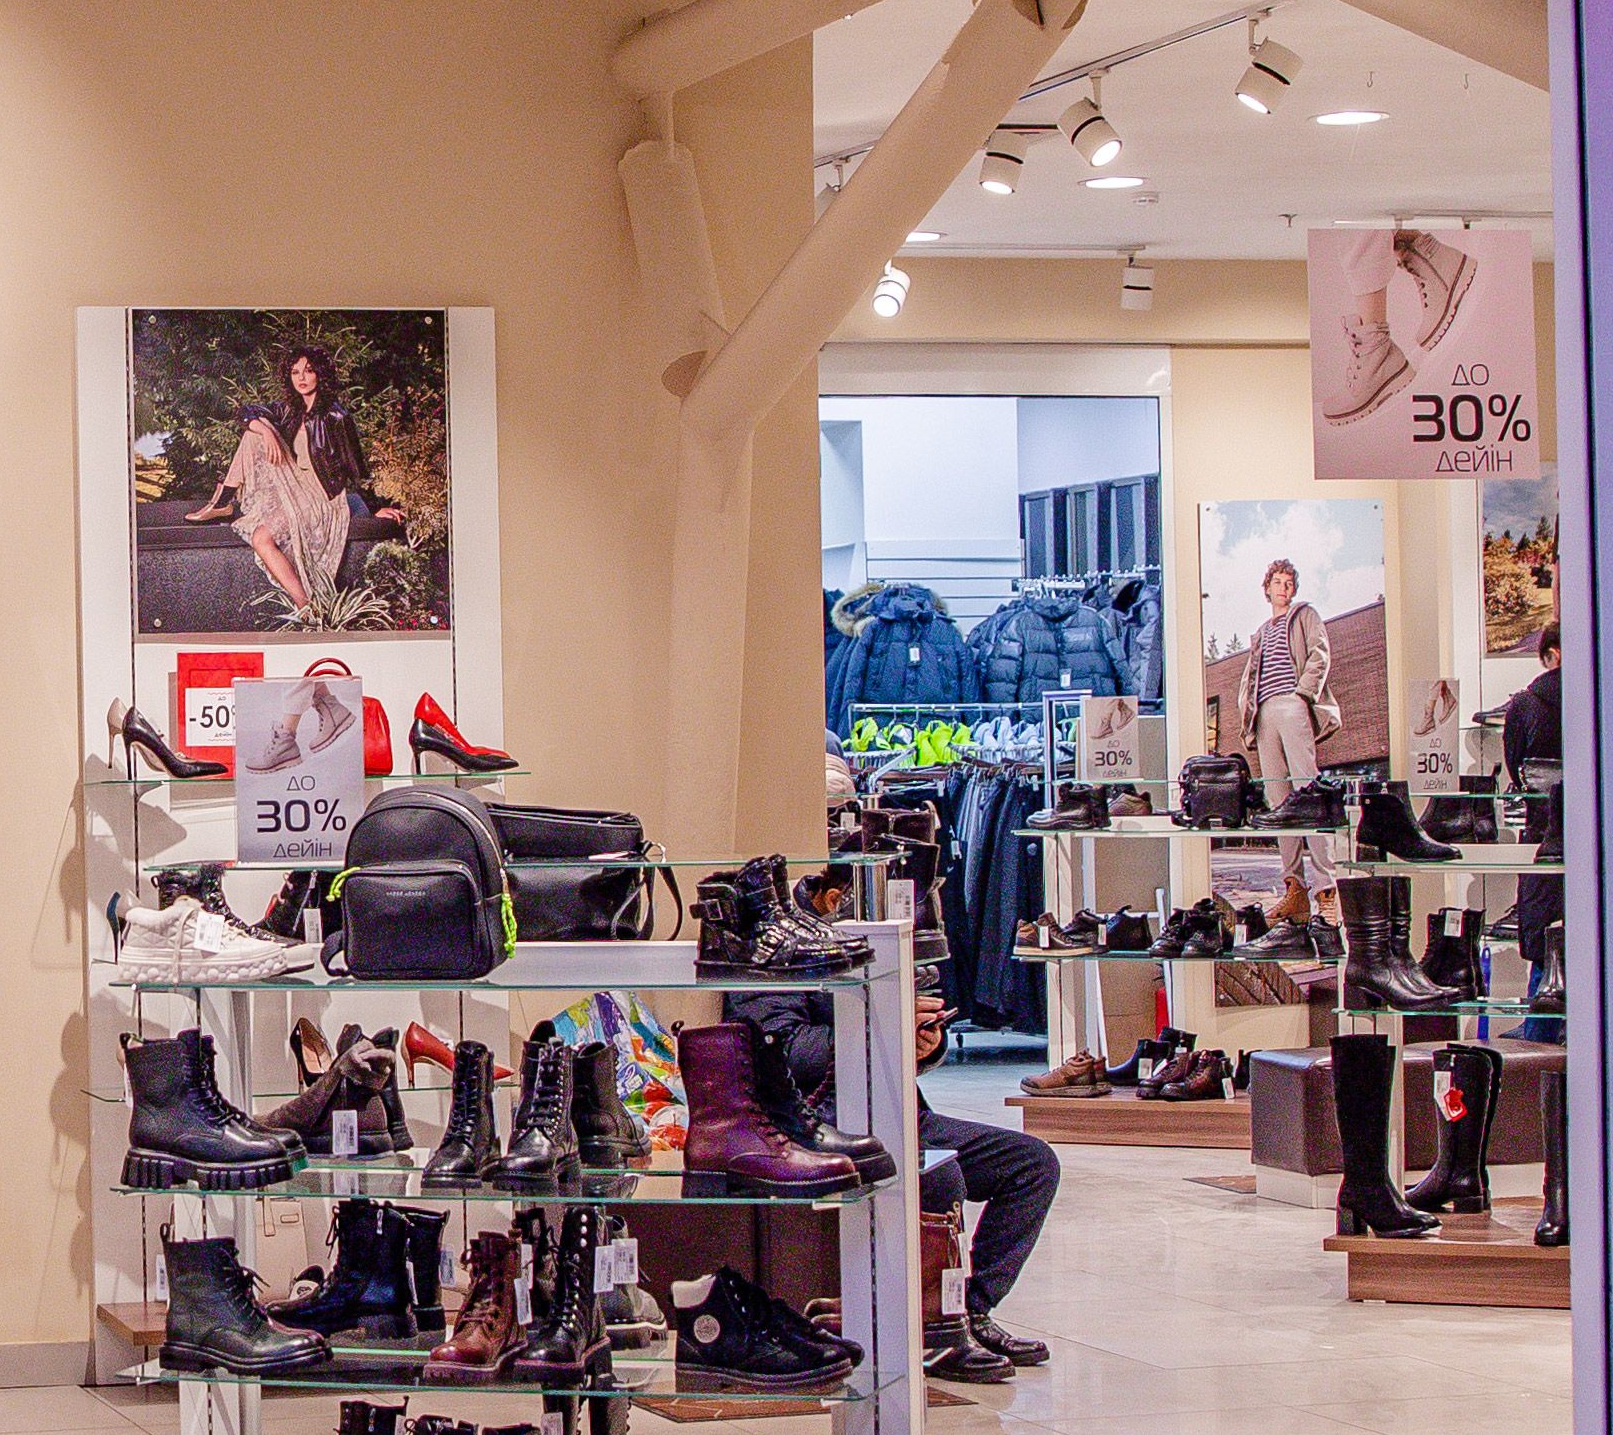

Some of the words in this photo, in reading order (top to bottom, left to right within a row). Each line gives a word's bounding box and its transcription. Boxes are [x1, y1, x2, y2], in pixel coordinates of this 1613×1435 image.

[1412, 393, 1531, 443] 30%
[1434, 444, 1513, 472] дейін
[1094, 750, 1133, 767] 30%
[1416, 752, 1453, 774] 30%
[256, 797, 348, 834] 30%
[273, 838, 333, 859] дейін
